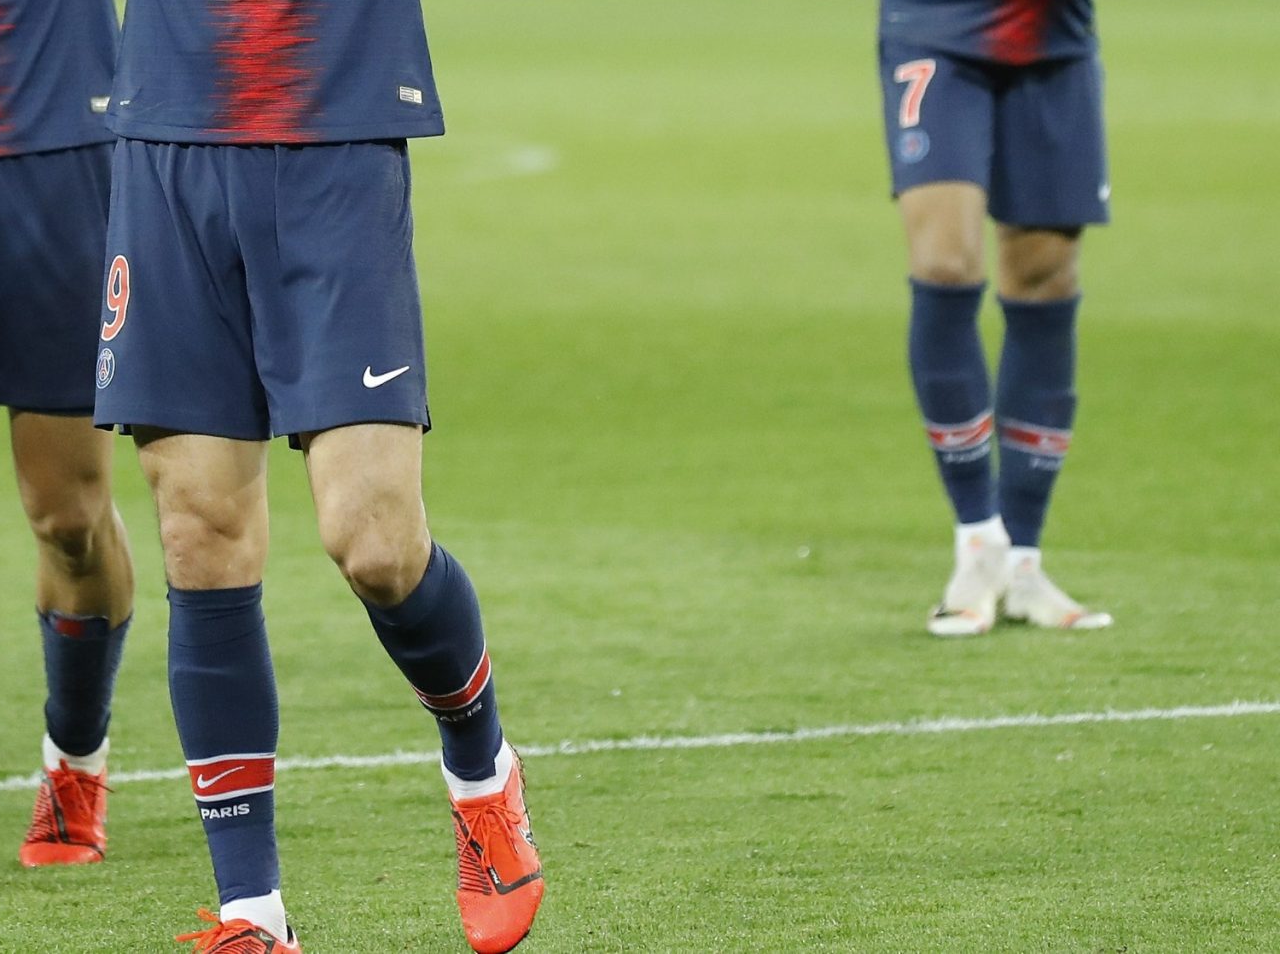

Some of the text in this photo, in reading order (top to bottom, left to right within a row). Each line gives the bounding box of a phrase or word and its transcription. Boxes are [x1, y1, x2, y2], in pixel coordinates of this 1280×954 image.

[893, 57, 937, 129] 7
[100, 254, 131, 341] 9
[200, 803, 251, 820] PARIS
